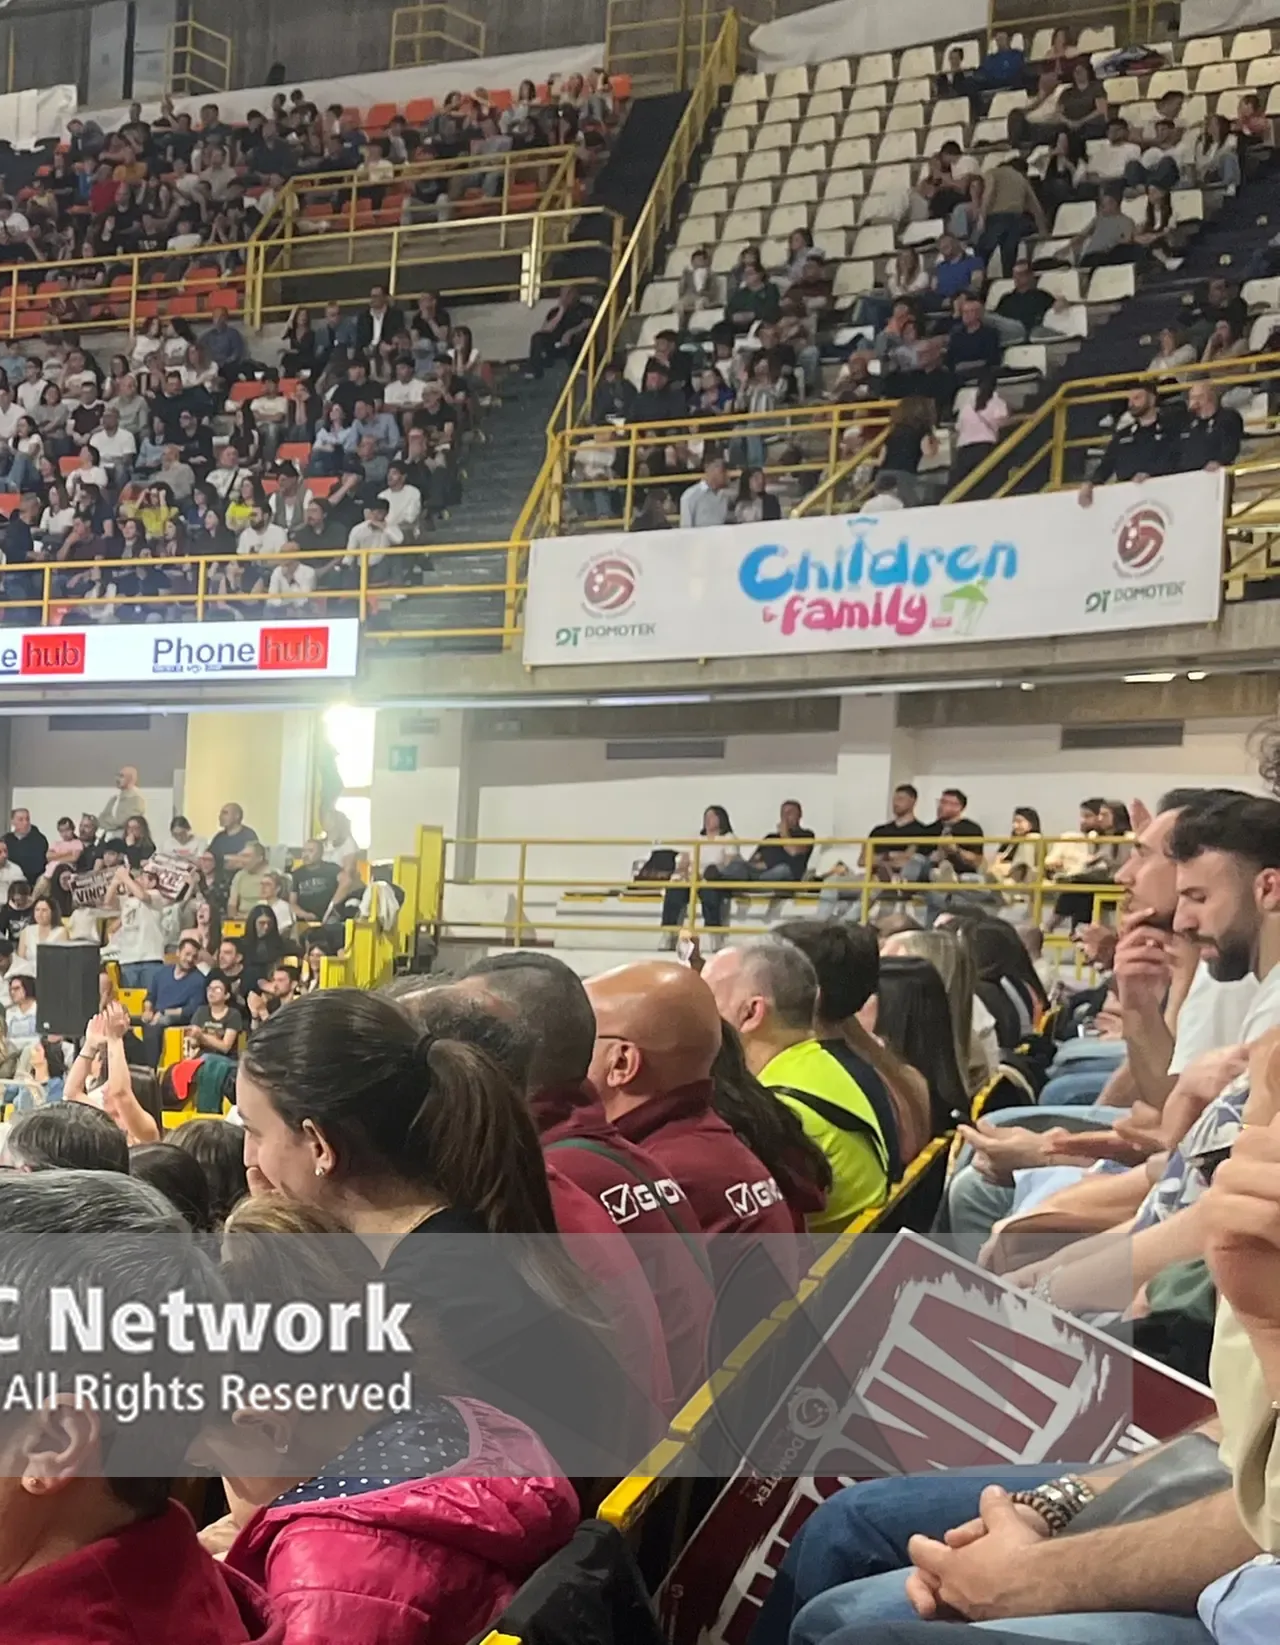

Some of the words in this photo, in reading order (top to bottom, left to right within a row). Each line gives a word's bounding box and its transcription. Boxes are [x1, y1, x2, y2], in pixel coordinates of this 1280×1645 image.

[738, 535, 1018, 603] Children
[1114, 581, 1186, 602] DOMOTEK
[781, 584, 928, 635] family
[585, 623, 655, 639] DOMOTEK
[27, 640, 79, 667] hub
[153, 637, 255, 664] Phone
[266, 634, 322, 662] hub
